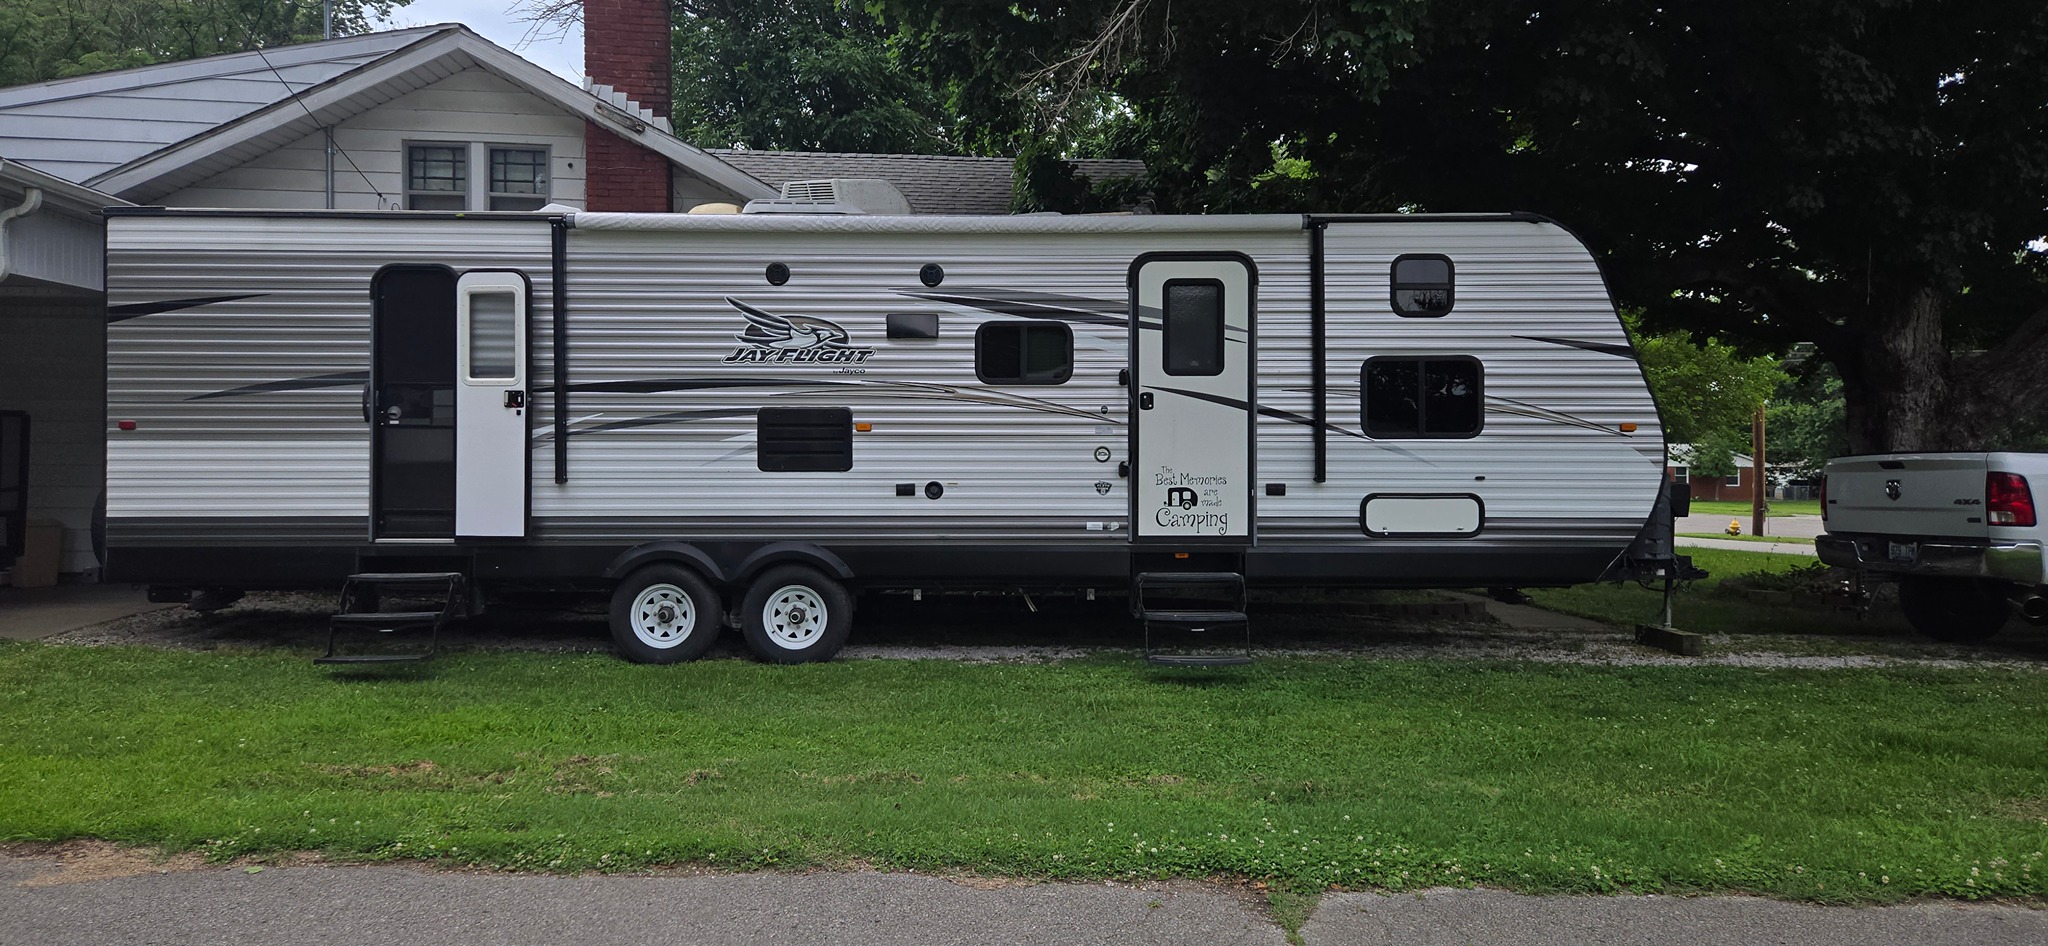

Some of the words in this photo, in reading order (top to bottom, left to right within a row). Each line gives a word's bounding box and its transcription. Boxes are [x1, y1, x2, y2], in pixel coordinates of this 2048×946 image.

[722, 346, 775, 363] JAY
[774, 346, 875, 363] FLIGHT
[839, 367, 866, 375] Jayco
[1161, 466, 1173, 474] The
[1155, 473, 1178, 486] Best
[1180, 473, 1227, 486] Memories
[1200, 496, 1222, 507] made
[1155, 507, 1228, 536] Camping
